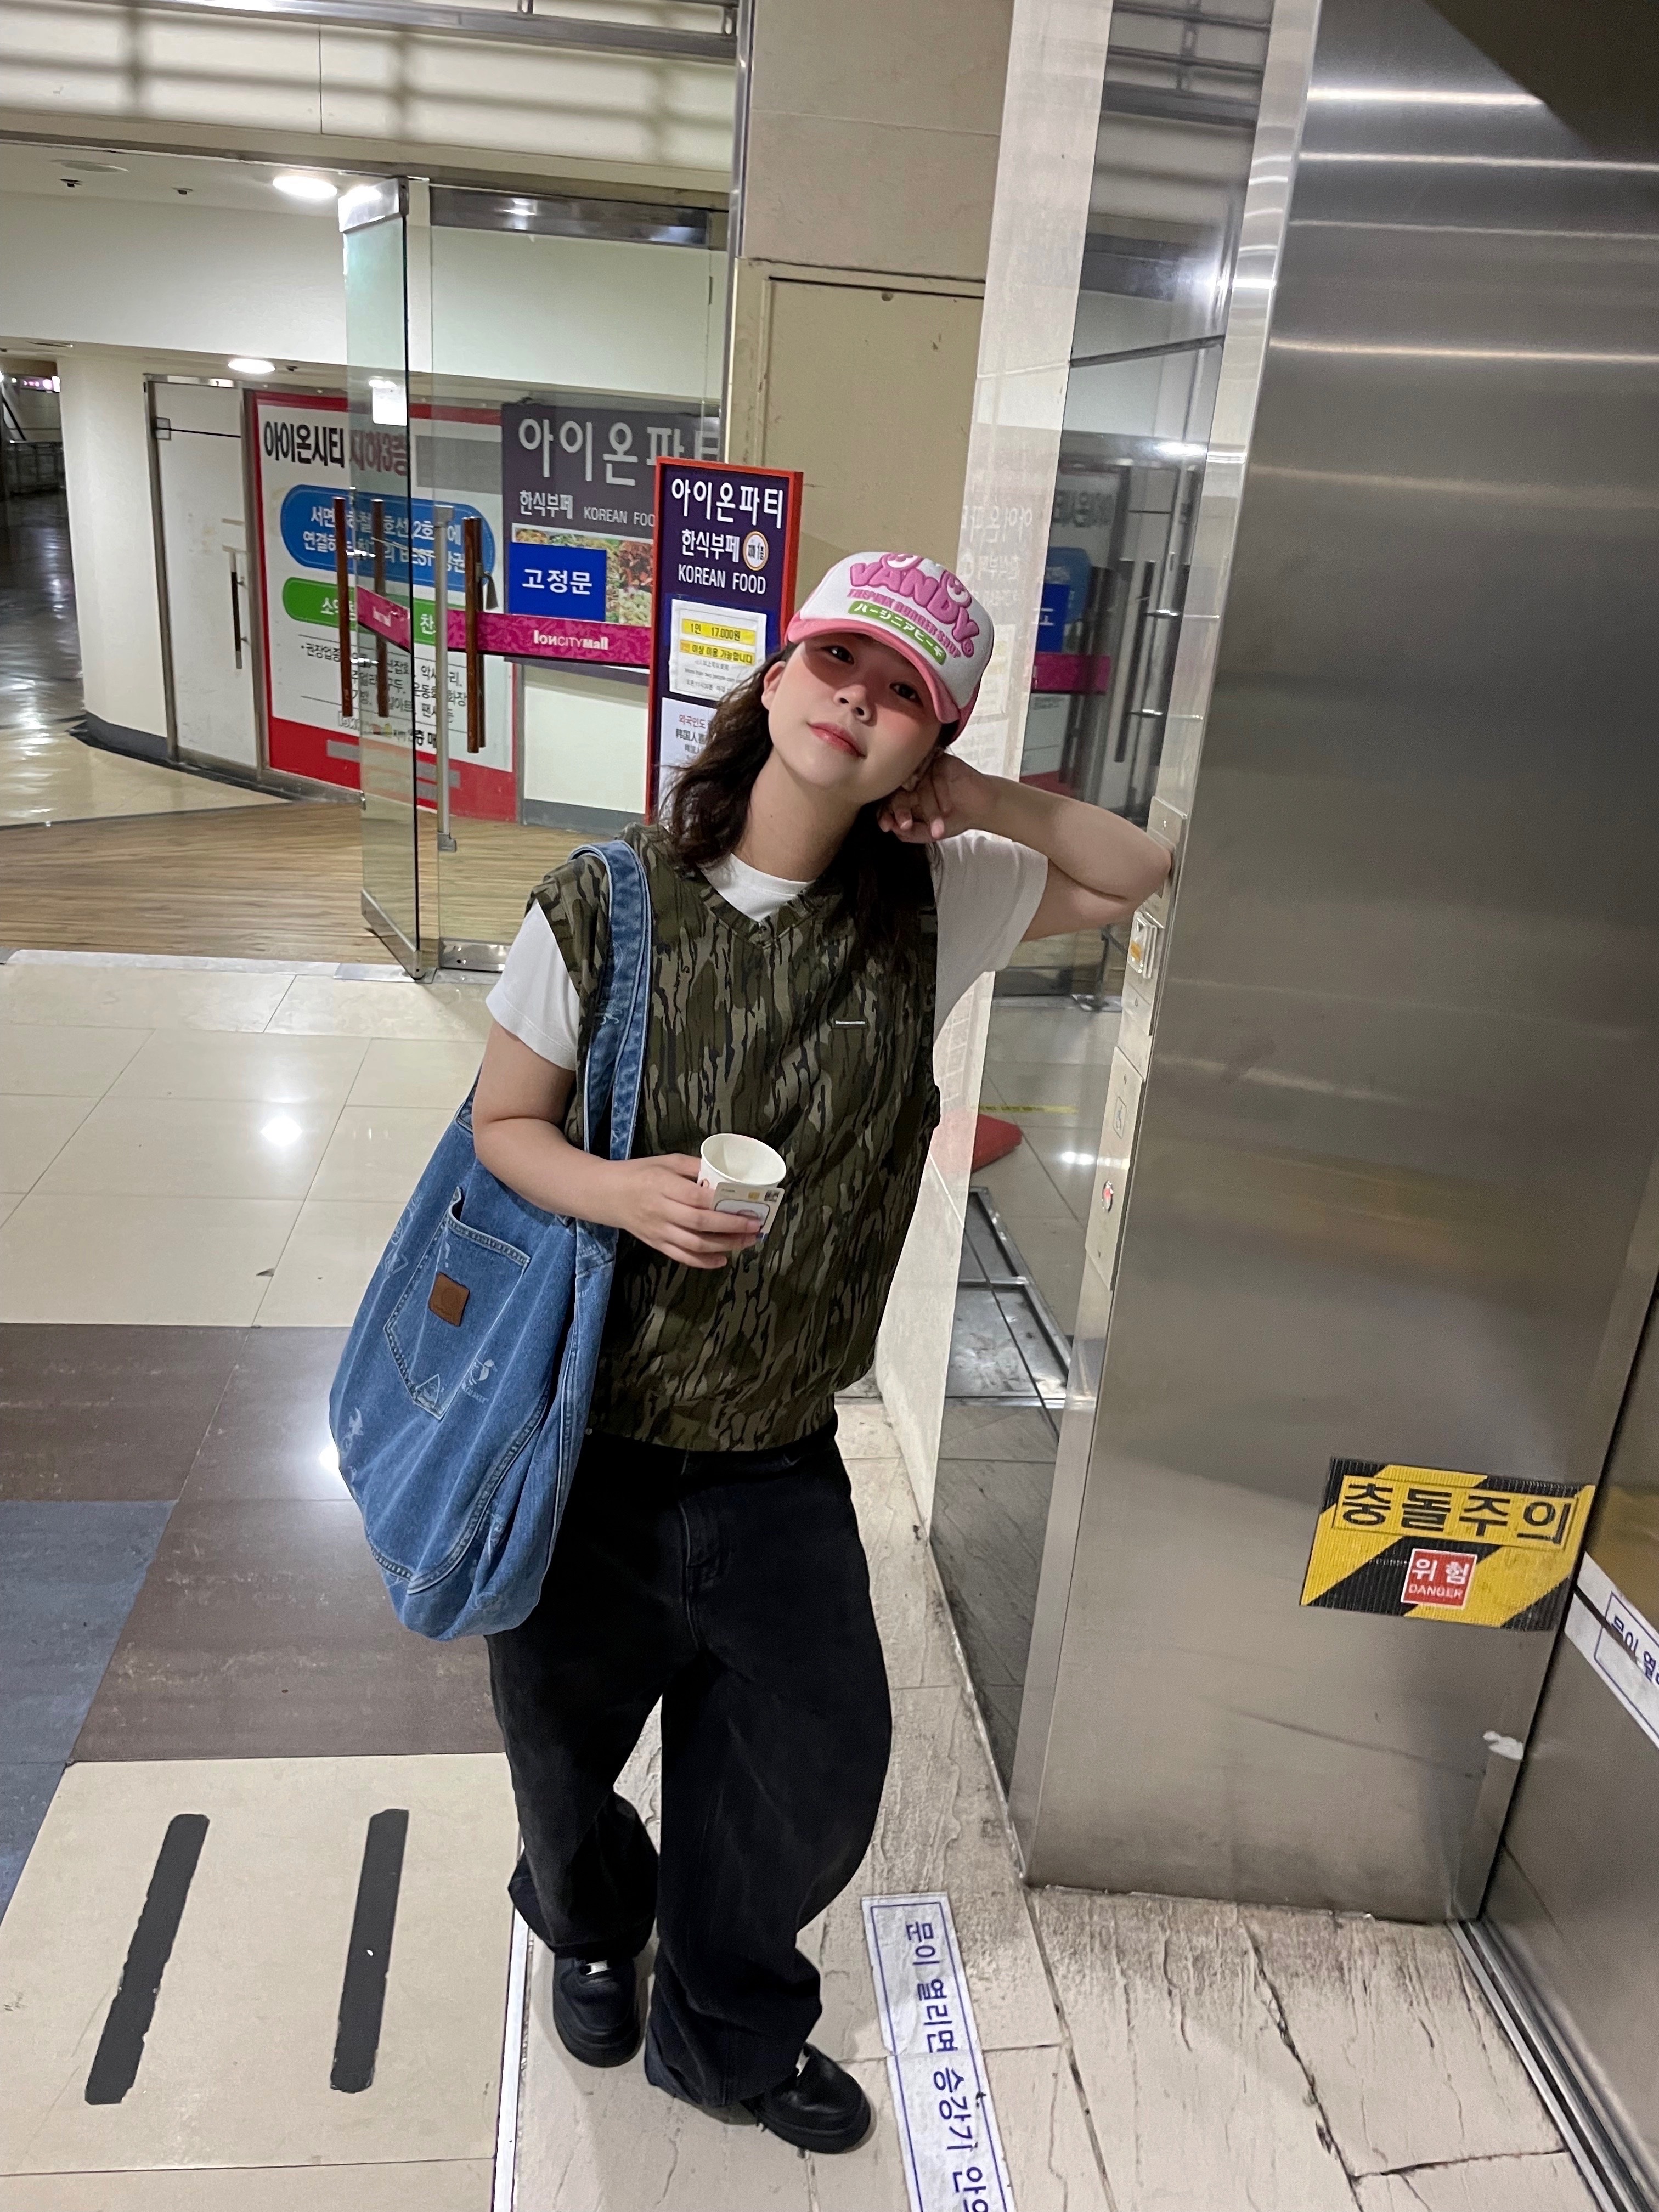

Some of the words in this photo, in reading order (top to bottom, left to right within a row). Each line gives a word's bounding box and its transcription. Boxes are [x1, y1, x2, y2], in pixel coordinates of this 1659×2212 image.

[264, 421, 345, 468] 아이온시티
[520, 490, 573, 519] 한식부페
[584, 506, 628, 524] KOREAN
[672, 478, 783, 529] 아이온파티
[682, 528, 740, 563] 한식부페
[522, 569, 592, 595] 고정문
[678, 564, 725, 588] KOREAN
[732, 572, 766, 594] FOOD
[850, 553, 979, 643] VANDY
[1342, 1483, 1571, 1544] 충돌주의
[1408, 1584, 1463, 1599] DANGER
[906, 1922, 940, 1965] 문이
[917, 1978, 958, 2053] 열리면
[934, 2067, 973, 2150] 승강기
